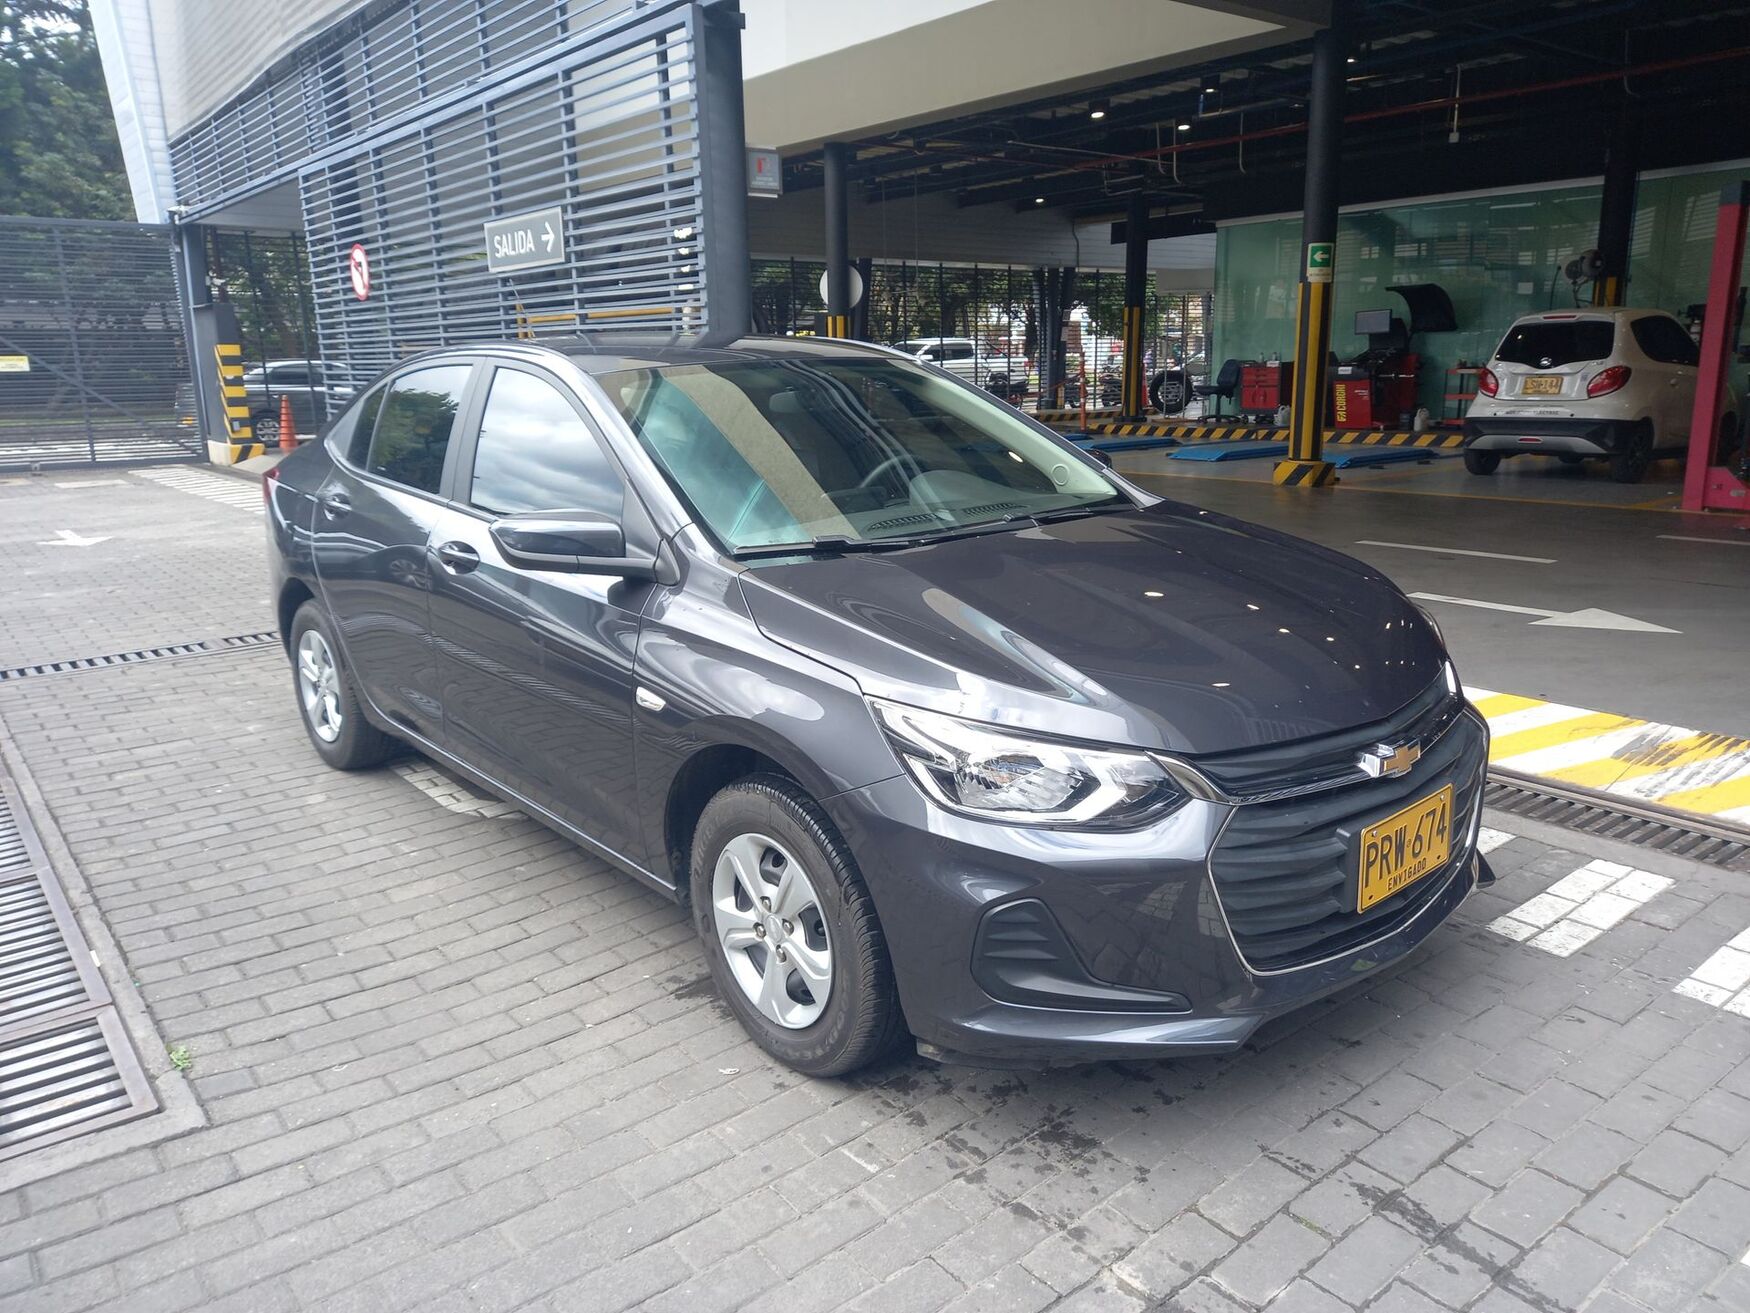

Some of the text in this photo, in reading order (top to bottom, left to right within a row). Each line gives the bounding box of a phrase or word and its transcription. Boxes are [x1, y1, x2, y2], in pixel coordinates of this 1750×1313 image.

[494, 229, 535, 258] SALIDA
[1336, 384, 1346, 410] CORGHI
[1365, 802, 1447, 888] PRW 674
[1387, 857, 1427, 891] ENVIGADO
